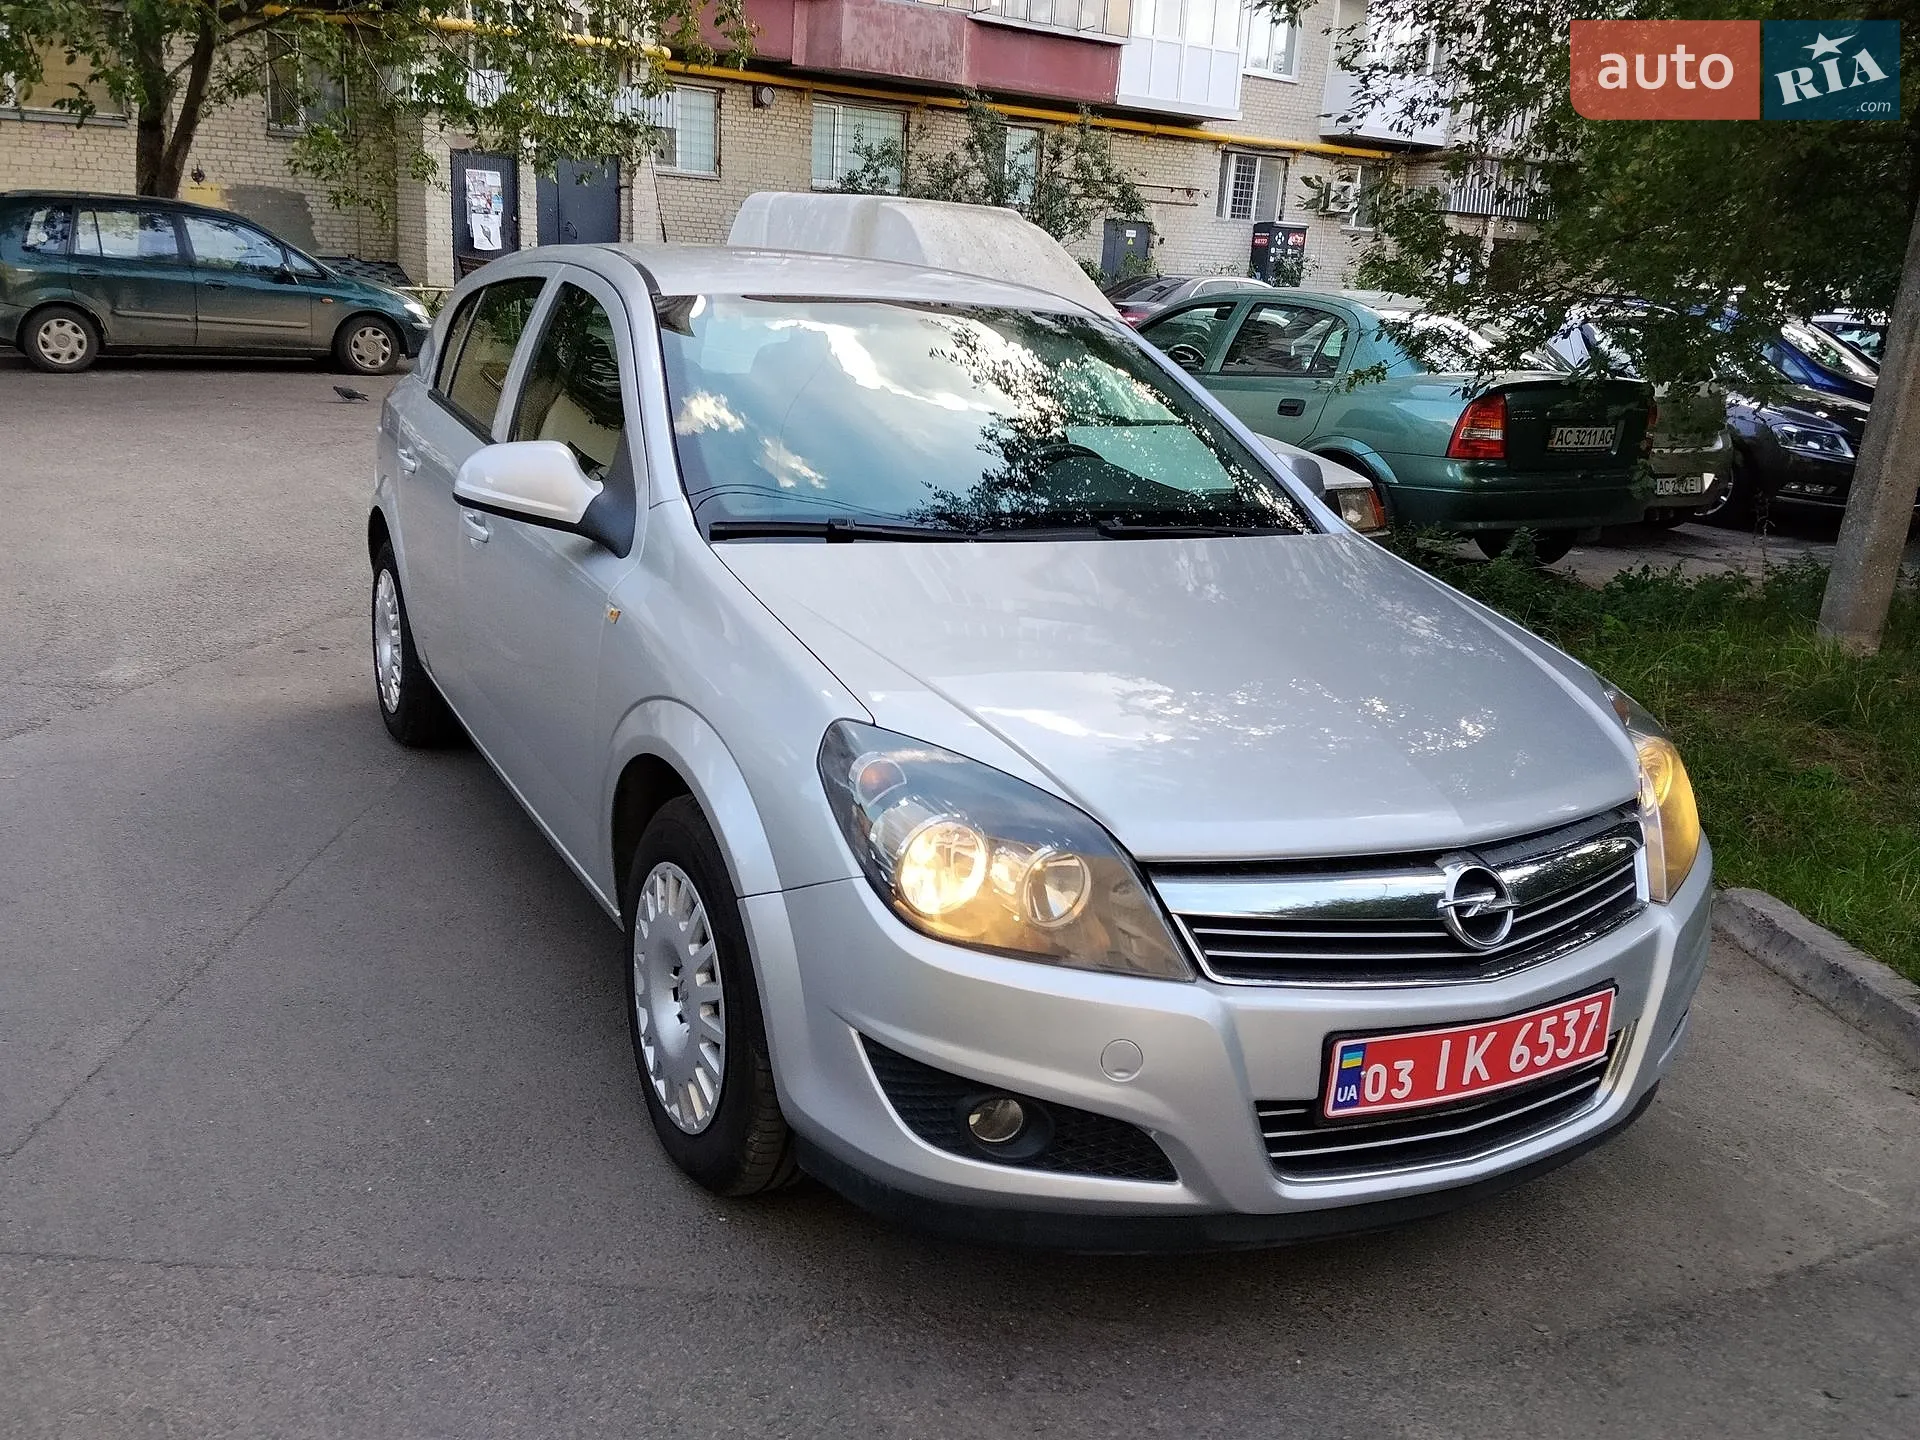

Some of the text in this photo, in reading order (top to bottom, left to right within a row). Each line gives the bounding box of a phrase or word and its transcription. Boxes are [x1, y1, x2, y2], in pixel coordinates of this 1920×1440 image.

[1555, 429, 1573, 446] AC
[1574, 429, 1597, 446] 3211
[1363, 1001, 1603, 1102] 03 IK 6537
[1337, 1084, 1358, 1103] UA
